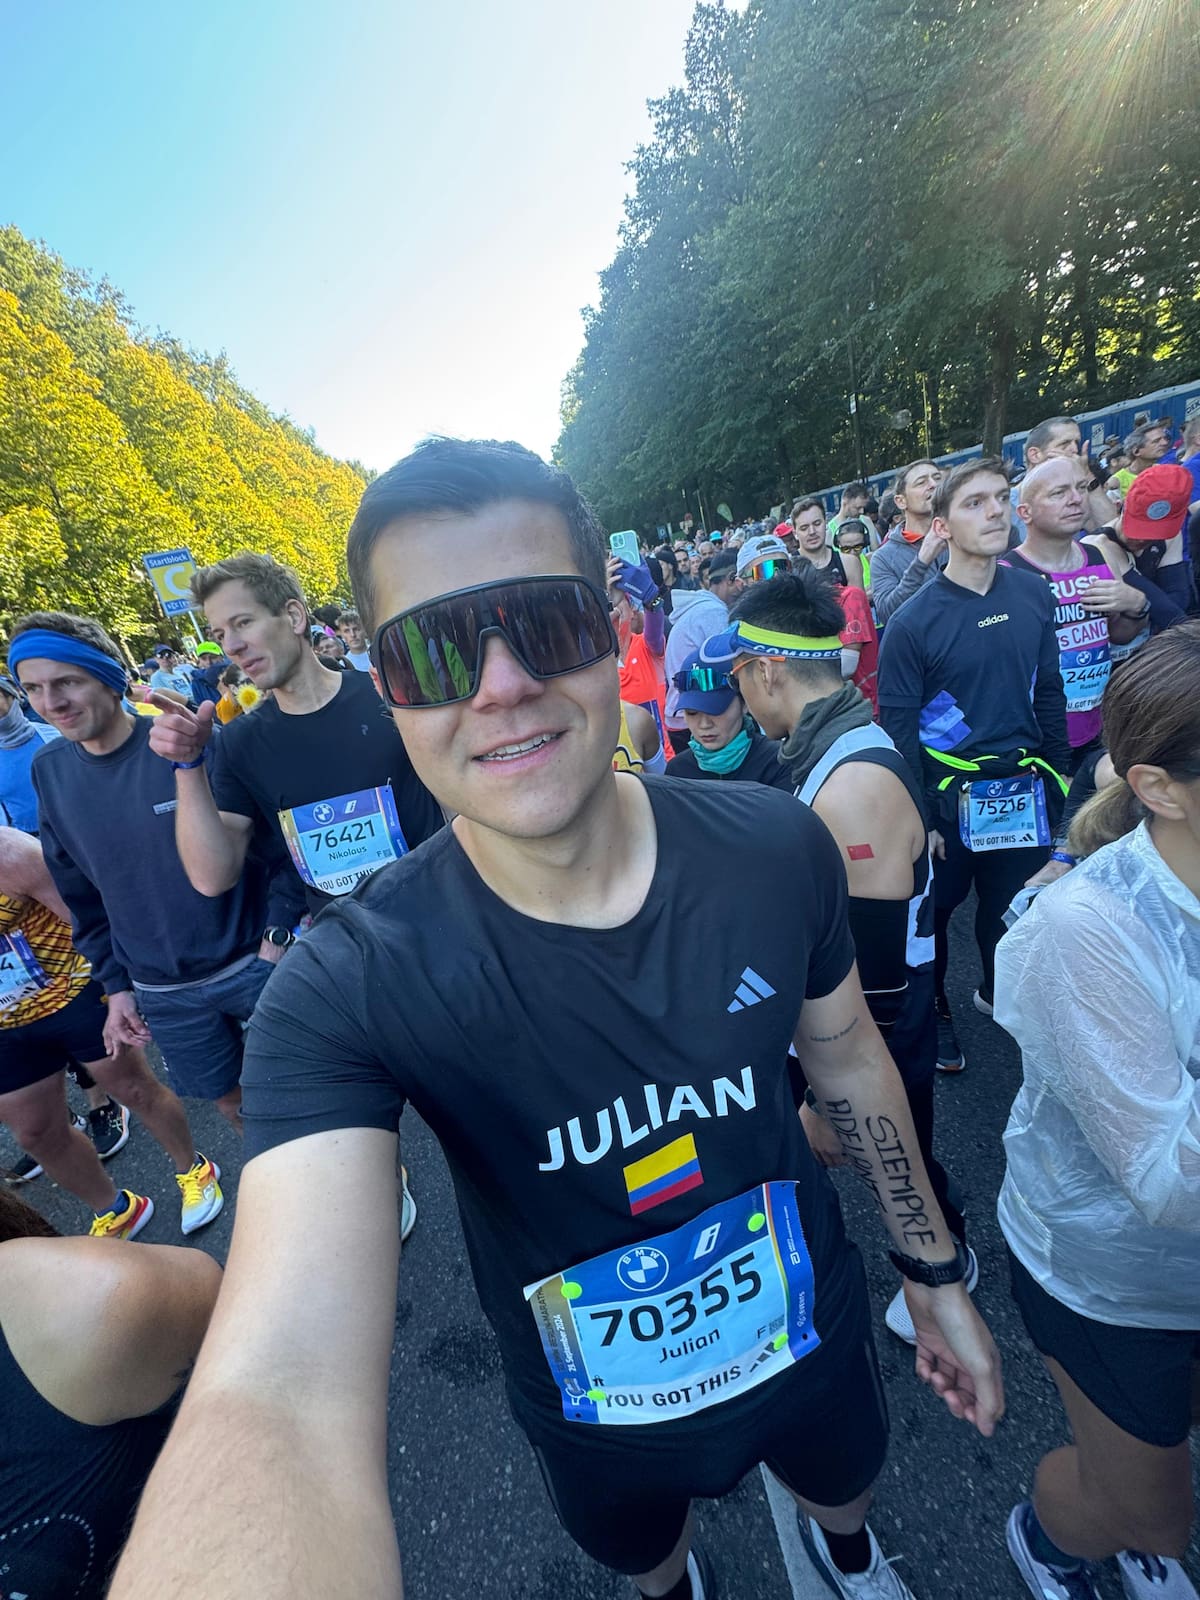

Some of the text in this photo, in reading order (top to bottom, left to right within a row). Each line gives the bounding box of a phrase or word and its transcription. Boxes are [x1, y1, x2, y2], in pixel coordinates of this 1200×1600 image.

[148, 552, 188, 568] Startblock
[164, 565, 193, 597] C
[977, 613, 1009, 628] adidas
[1054, 603, 1085, 623] UNG
[1071, 620, 1107, 644] CANC
[1065, 663, 1110, 684] 24444
[976, 797, 1026, 816] 75216
[309, 819, 376, 853] 76421
[972, 835, 1016, 848] YOU GOT THIS
[318, 880, 335, 891] YOU
[336, 874, 354, 887] GOT
[538, 1065, 757, 1172] JULIAN
[865, 1115, 937, 1248] SIEMPRE
[590, 1252, 762, 1347] 70355
[757, 1325, 766, 1339] F
[659, 1328, 720, 1364] Julian
[606, 1365, 742, 1408] YOU GOT THIS
